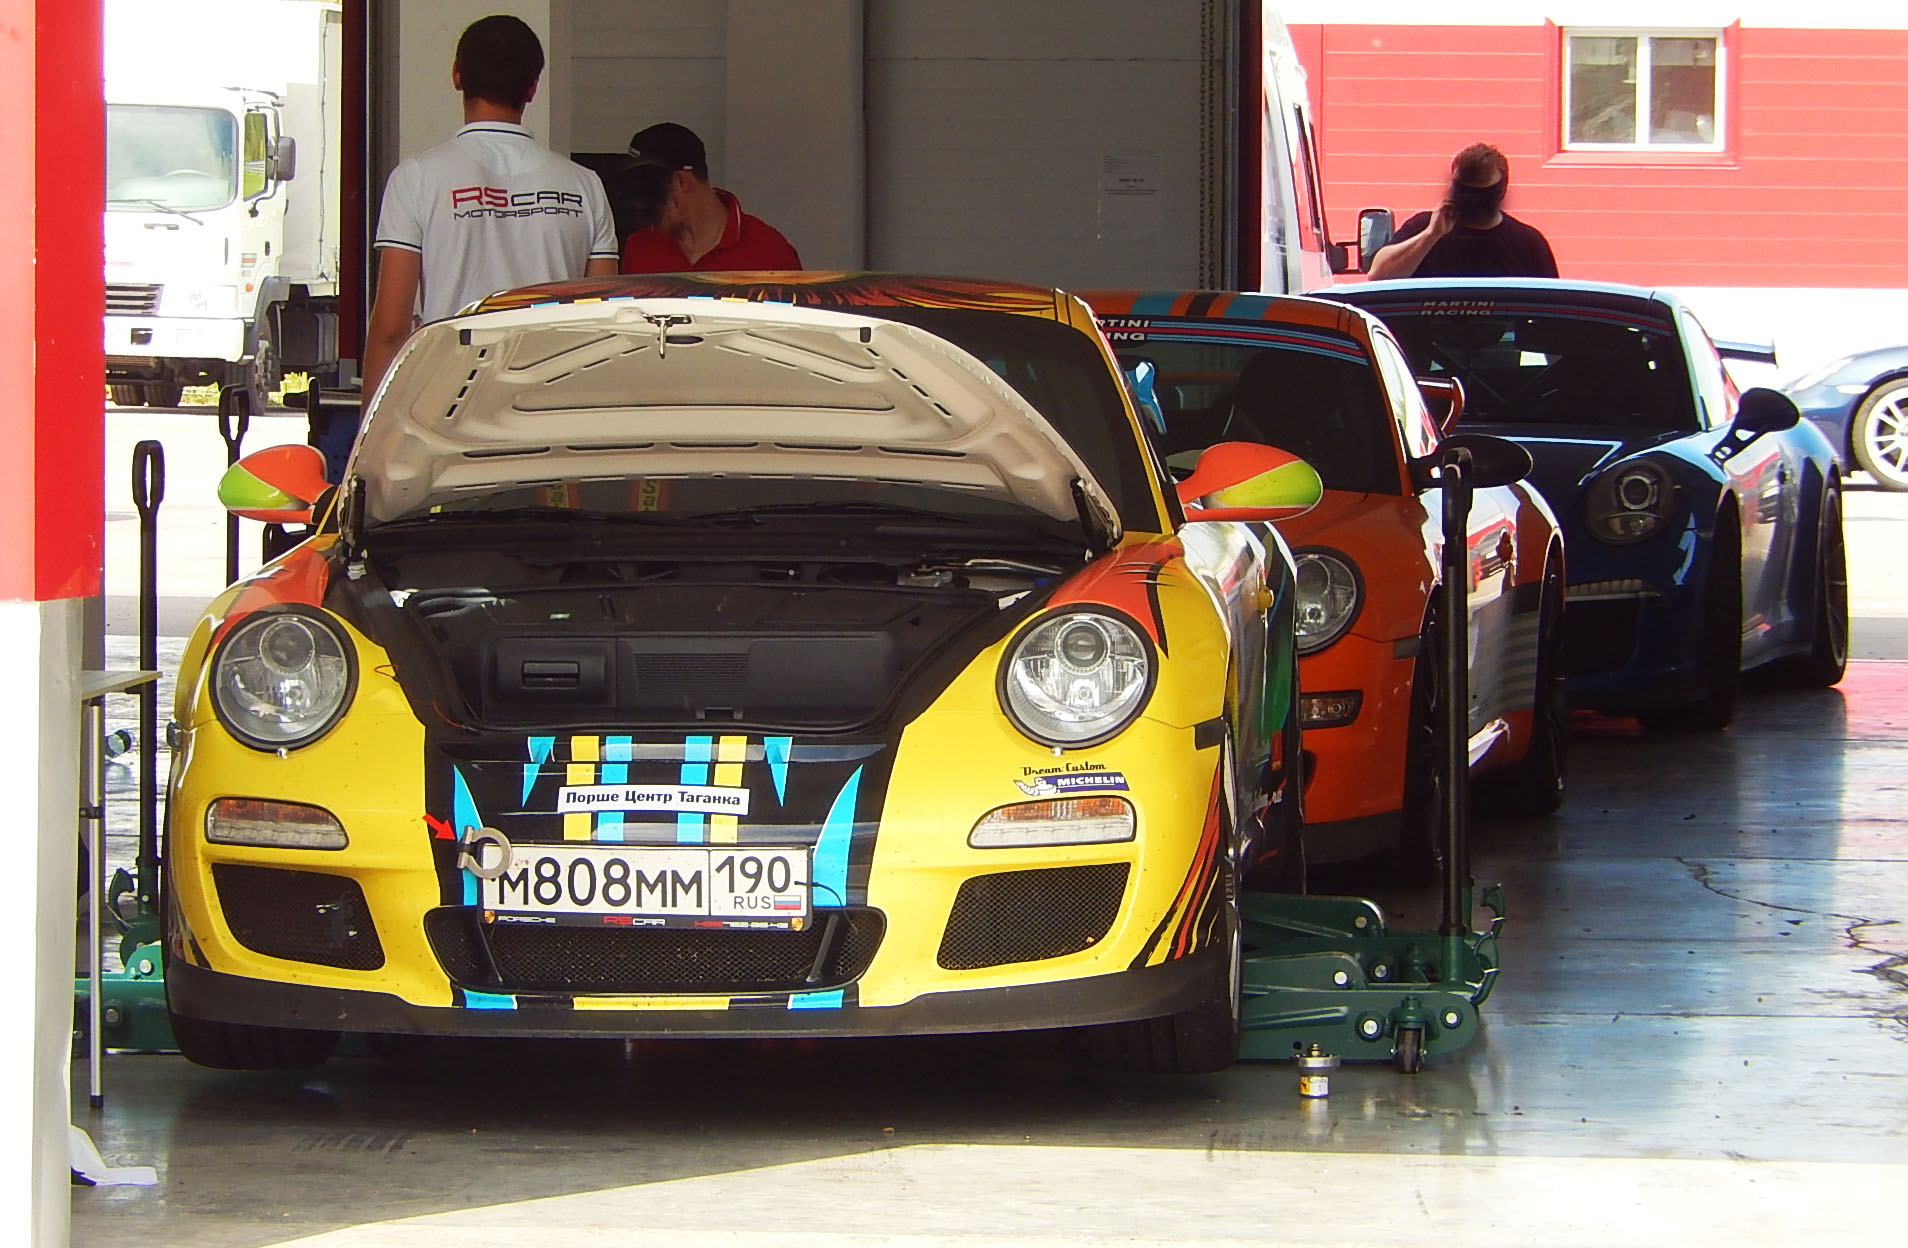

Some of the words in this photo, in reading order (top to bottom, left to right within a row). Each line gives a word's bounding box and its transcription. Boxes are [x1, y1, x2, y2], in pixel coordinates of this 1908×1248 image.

[454, 207, 583, 220] MOTORSPORT
[1022, 767, 1062, 776] Dream
[1065, 761, 1107, 772] Custom
[1057, 776, 1125, 787] MICHELIN
[566, 791, 619, 804] Порше
[625, 790, 673, 804] Центр
[678, 791, 741, 806] Таганка
[715, 855, 791, 894] 190
[733, 895, 772, 910] RUS
